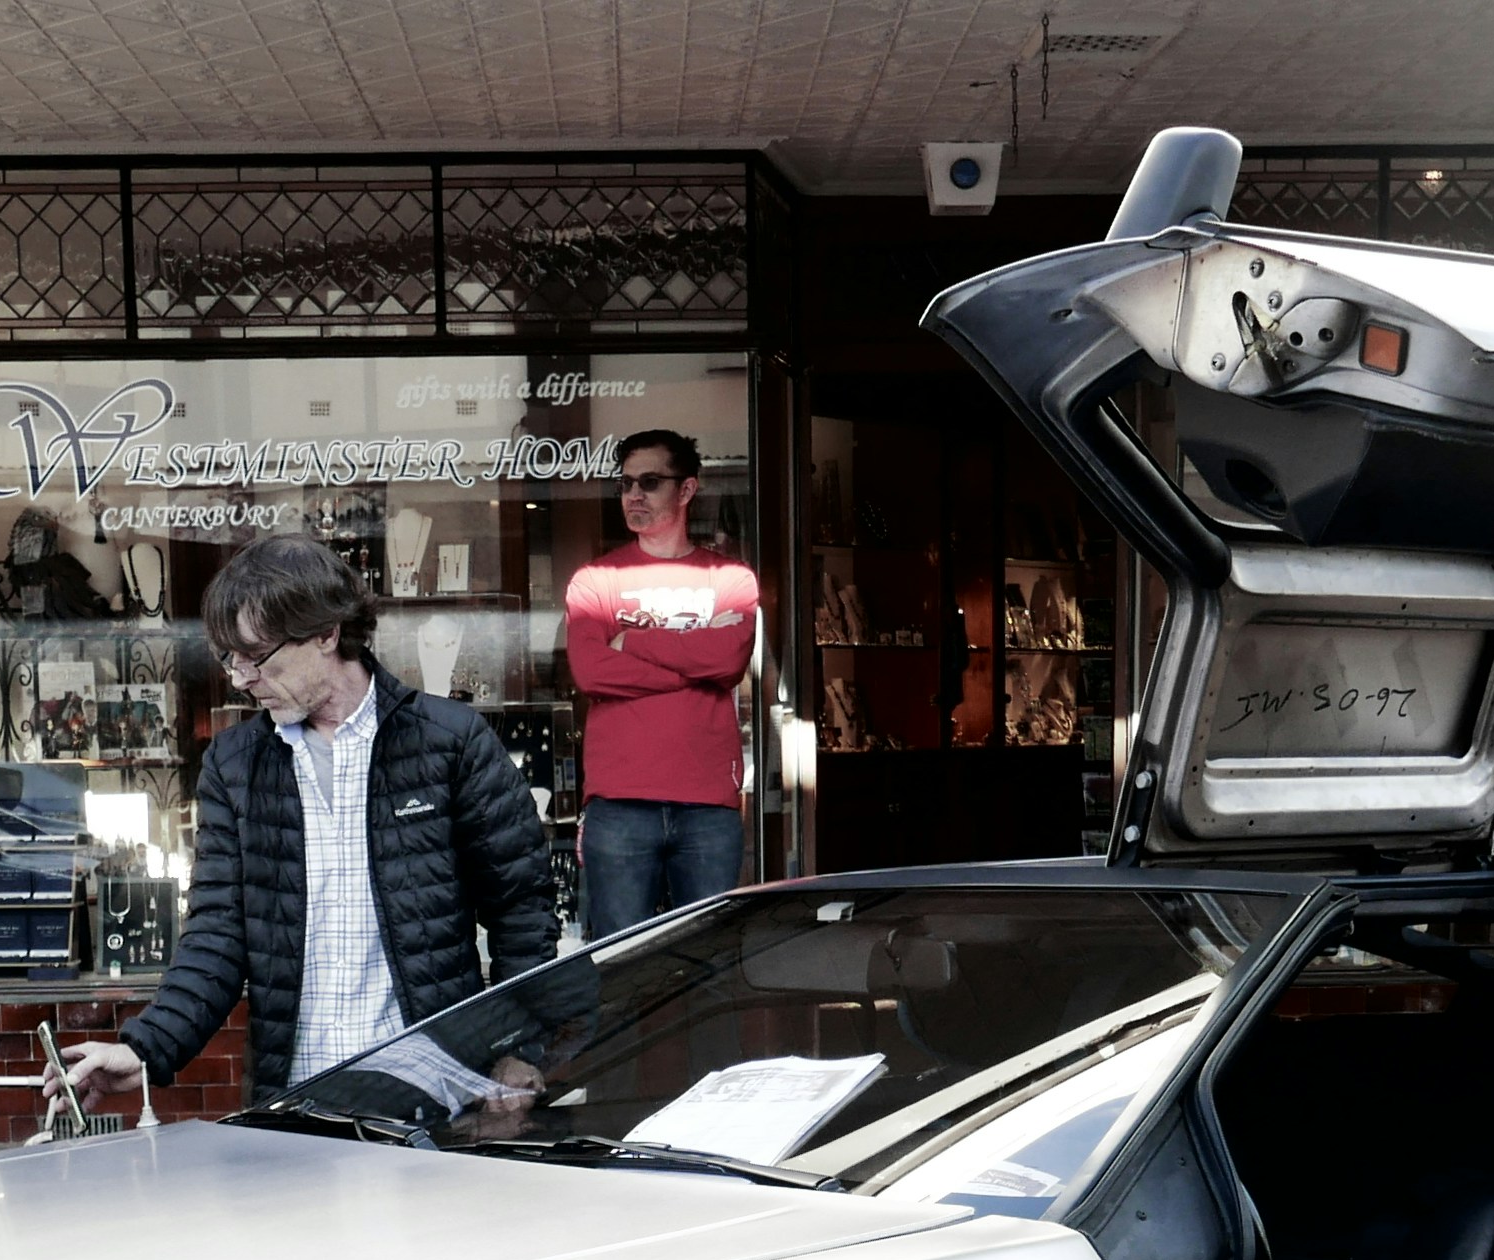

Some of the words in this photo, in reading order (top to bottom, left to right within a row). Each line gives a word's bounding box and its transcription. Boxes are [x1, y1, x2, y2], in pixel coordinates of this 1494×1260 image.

[396, 374, 451, 408] gifts
[457, 374, 510, 400] with
[516, 382, 532, 400] a
[536, 372, 646, 406] difference
[483, 433, 625, 483] HOM
[101, 502, 287, 532] CANTERBURY
